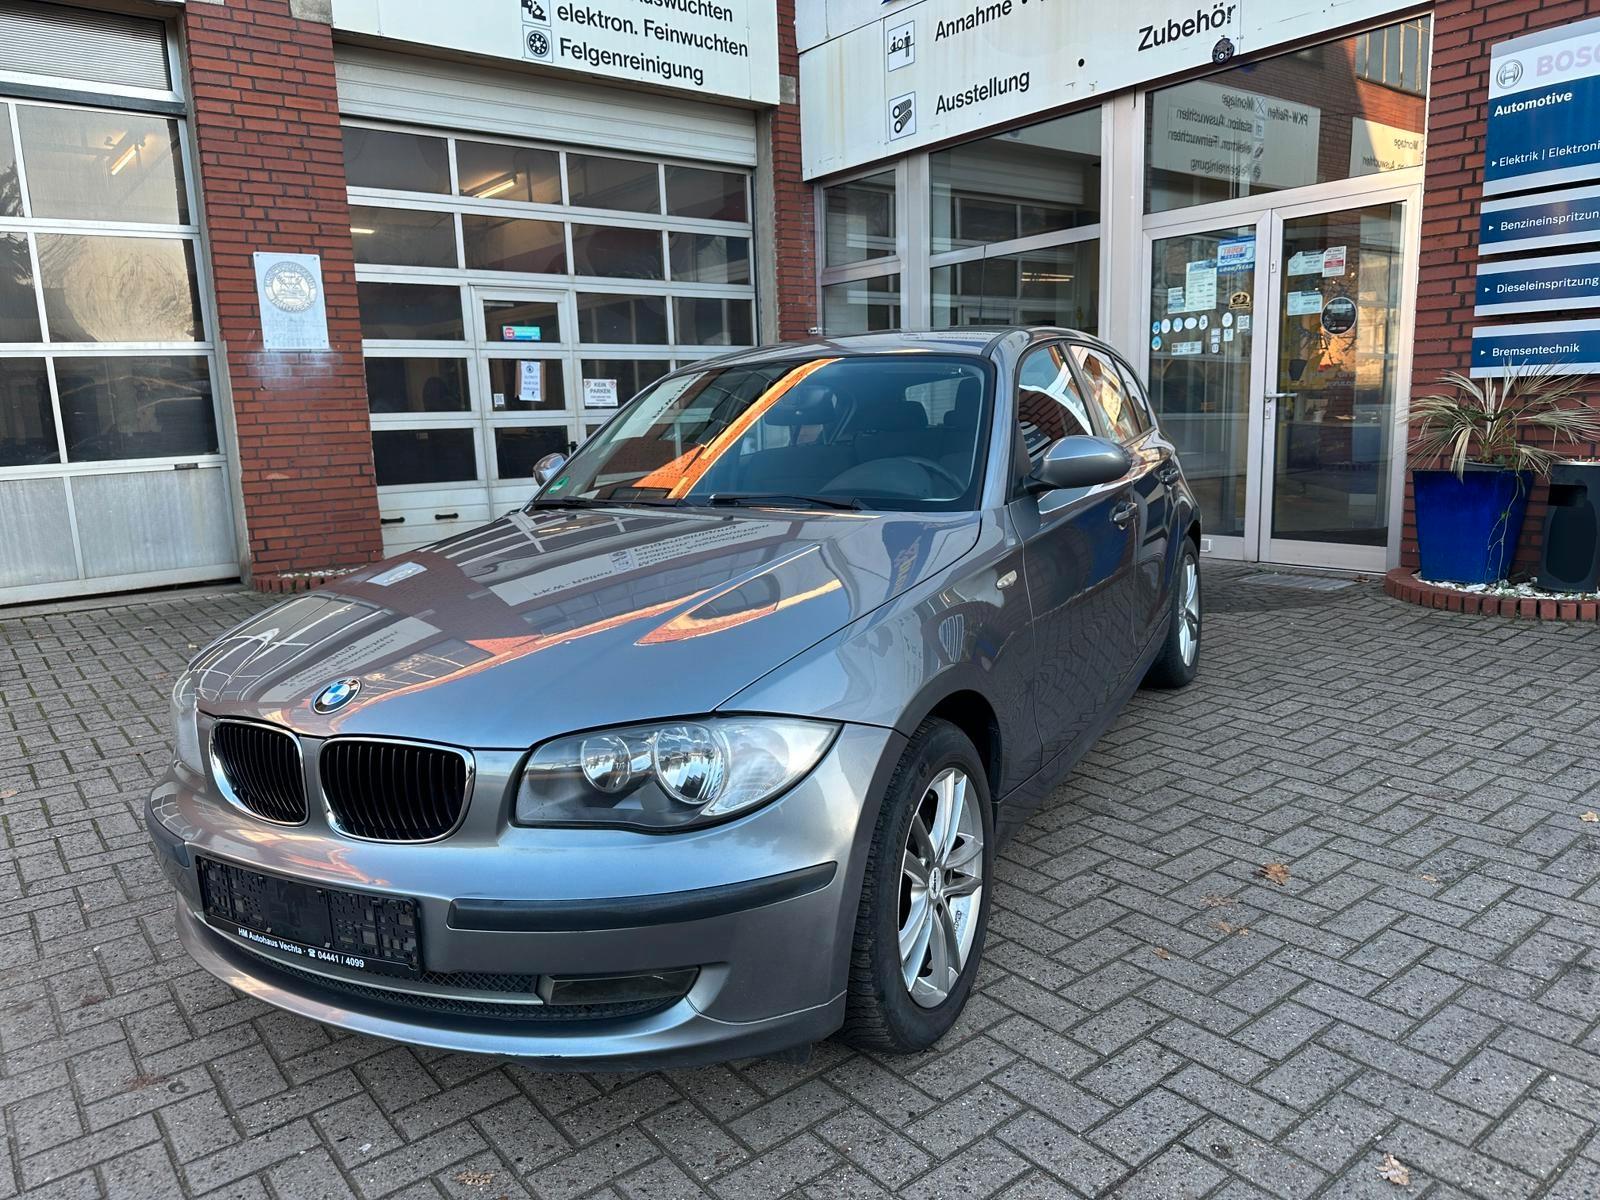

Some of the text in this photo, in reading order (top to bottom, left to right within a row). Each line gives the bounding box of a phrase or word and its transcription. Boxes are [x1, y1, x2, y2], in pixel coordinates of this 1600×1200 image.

[638, 0, 733, 22] swuchten
[935, 1, 1012, 42] Annahme
[1138, 2, 1236, 52] Zubehör
[557, 4, 748, 57] elektron. Feinwuchten
[560, 37, 703, 85] Felgenreinigung
[936, 71, 1030, 115] Ausstellung
[1494, 91, 1573, 117] Automotive
[1500, 151, 1539, 167] Elektrik
[1549, 140, 1600, 158] Elektroni
[1500, 210, 1600, 231] Benzineinspritzun
[1496, 277, 1600, 294] Dieseleinspritzung
[1492, 343, 1580, 357] Bremsentechnik
[238, 927, 249, 939] HM
[249, 932, 278, 949] Autohaus
[279, 940, 302, 955] Vechta
[317, 950, 339, 965] 04441
[345, 956, 365, 969] 4099
